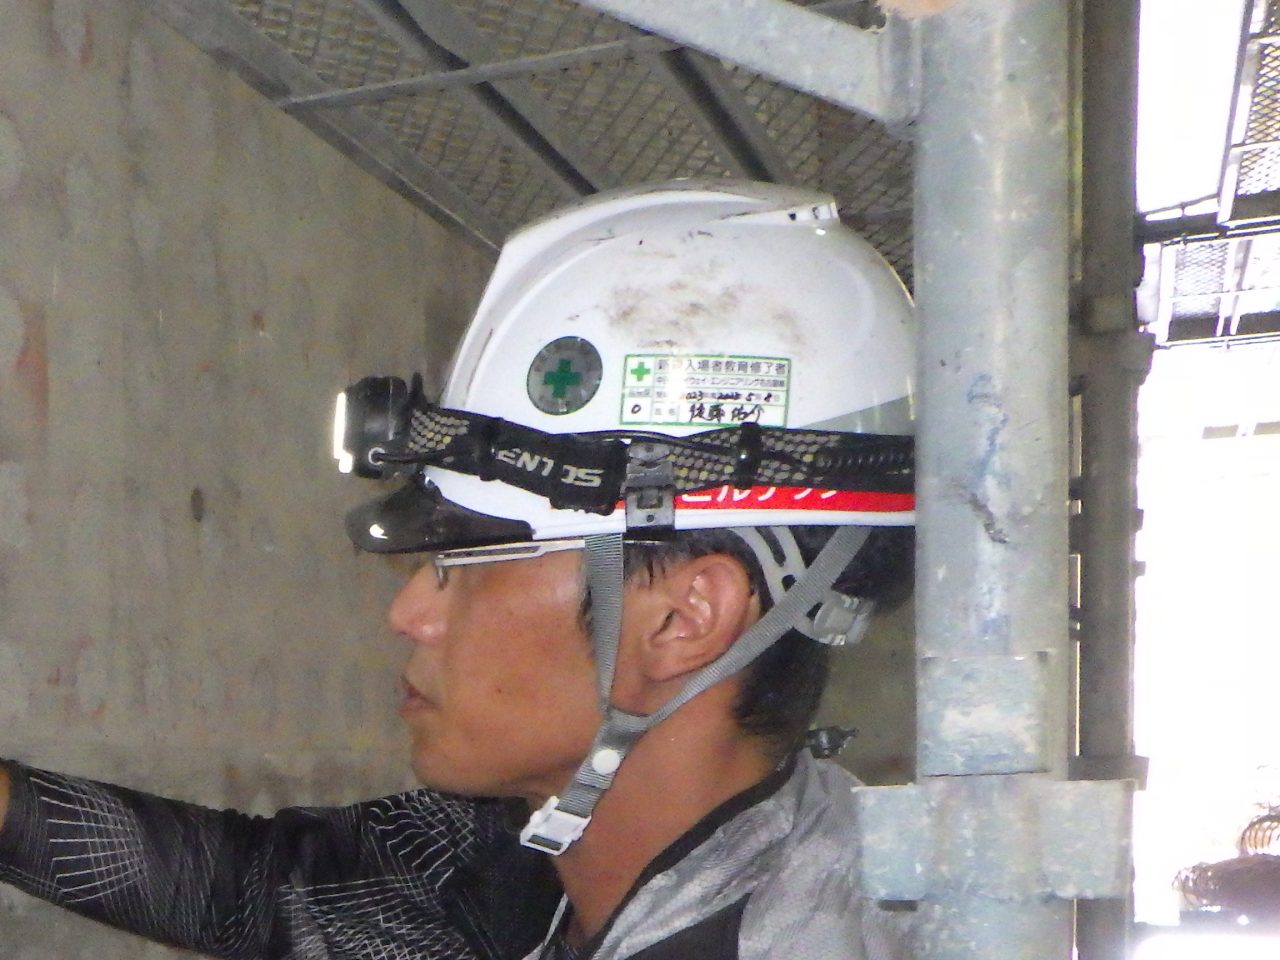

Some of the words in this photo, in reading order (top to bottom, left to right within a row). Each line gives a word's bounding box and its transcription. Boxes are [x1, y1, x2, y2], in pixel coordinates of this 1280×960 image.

[657, 358, 786, 375] 新入場者教育修了者
